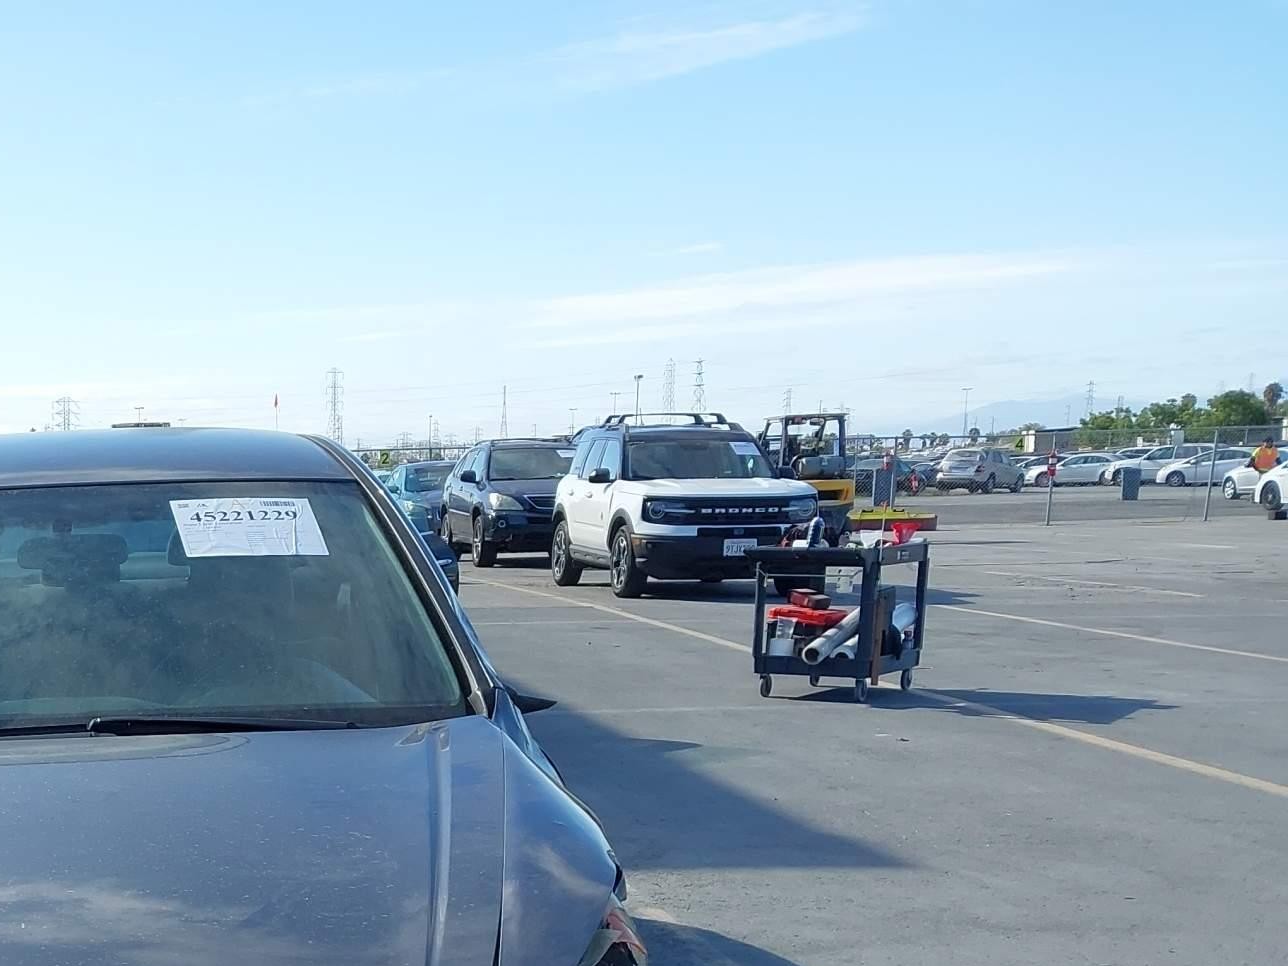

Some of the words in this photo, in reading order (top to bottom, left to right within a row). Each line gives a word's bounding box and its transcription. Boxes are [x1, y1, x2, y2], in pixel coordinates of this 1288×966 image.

[1015, 437, 1024, 450] 4
[381, 453, 389, 464] 2
[189, 510, 298, 522] 45221229
